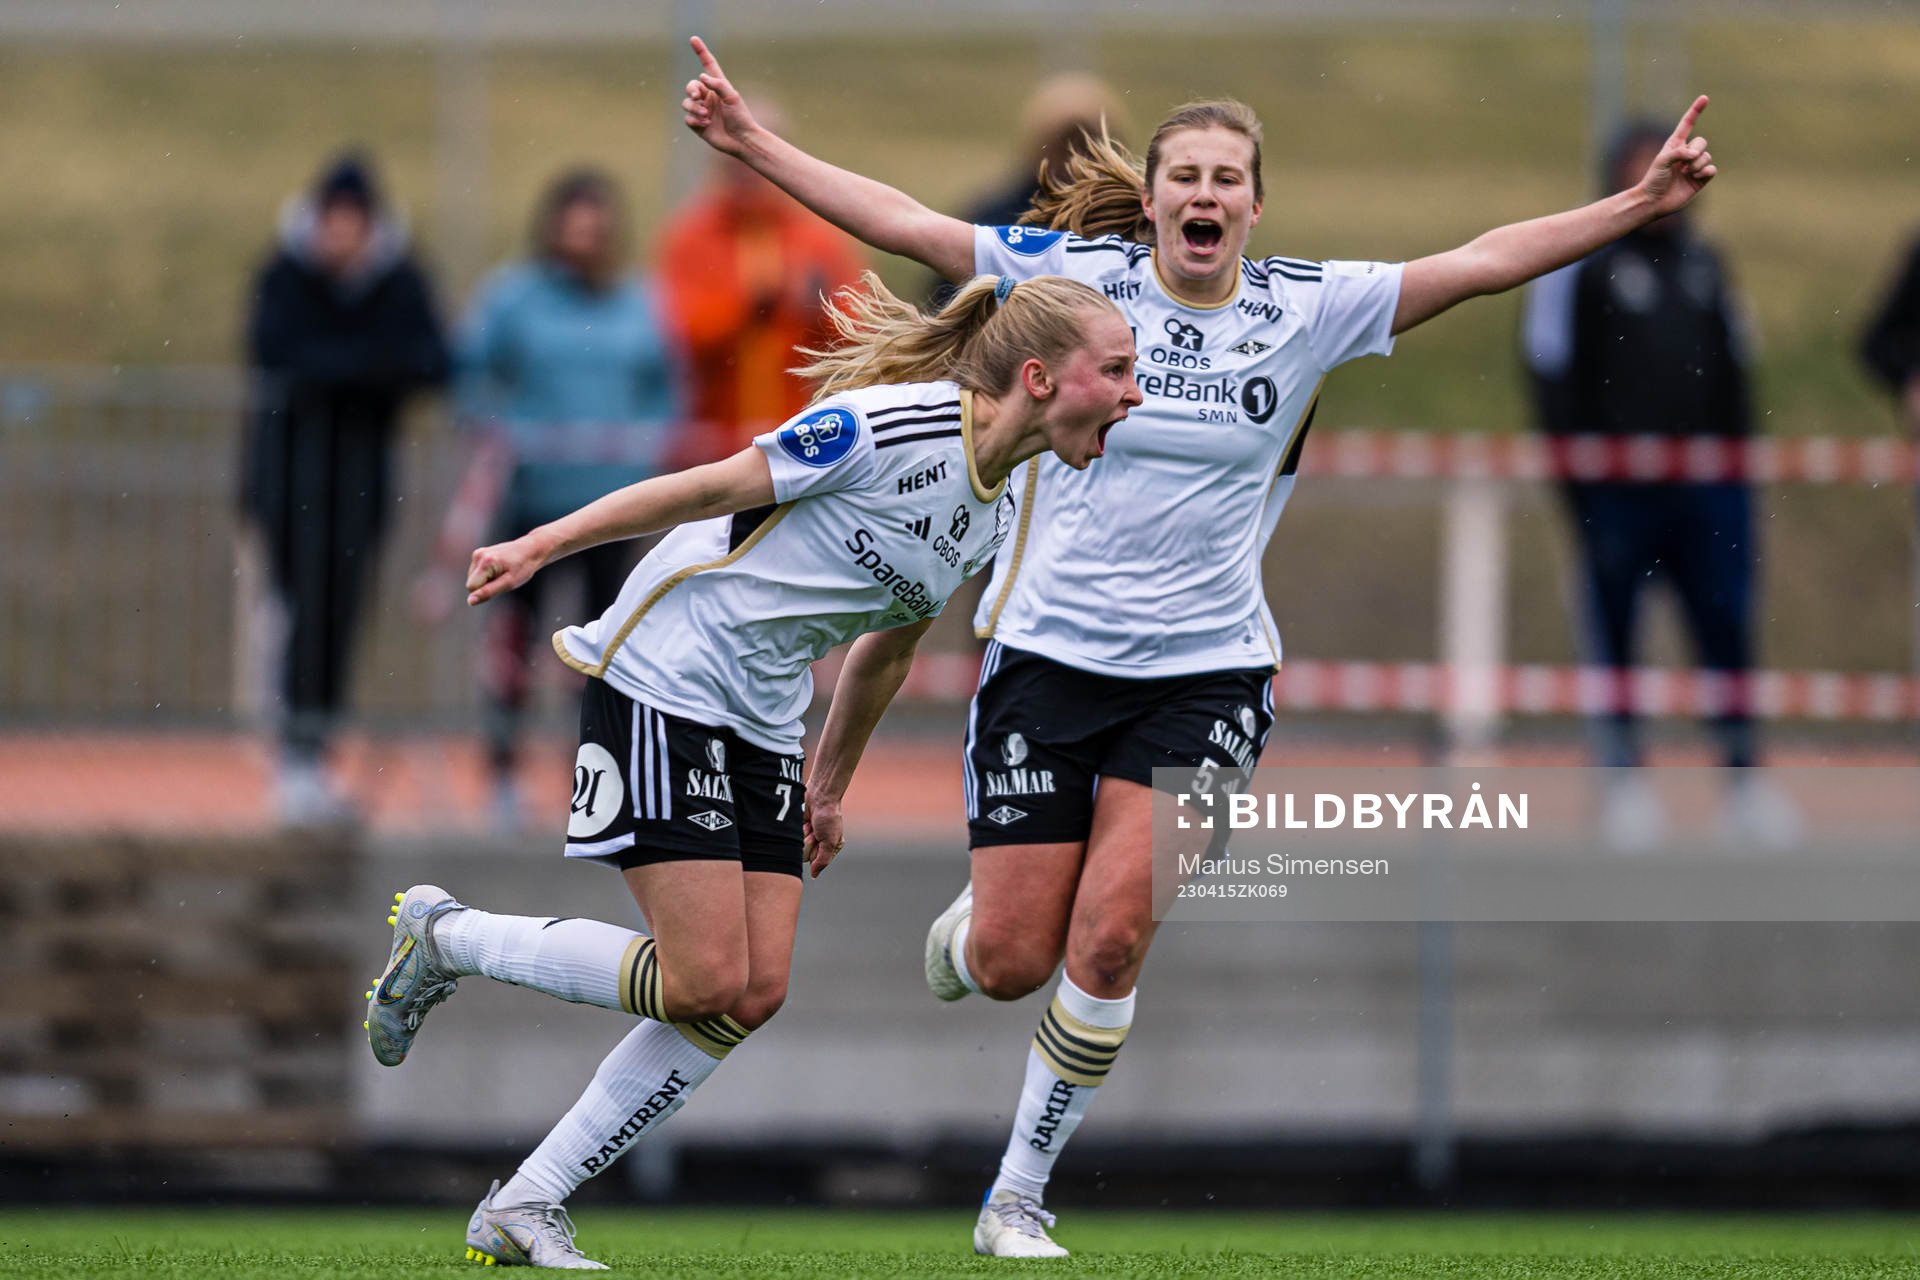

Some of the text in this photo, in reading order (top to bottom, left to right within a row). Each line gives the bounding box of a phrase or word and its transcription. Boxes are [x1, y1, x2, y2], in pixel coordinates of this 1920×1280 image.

[1150, 347, 1212, 370] OBOS
[1198, 408, 1238, 423] SMN
[898, 460, 947, 495] HENT
[933, 535, 961, 568] OBOS
[845, 528, 939, 619] SpareBank
[1191, 756, 1220, 794] 5
[775, 783, 792, 821] 7
[581, 1069, 690, 1175] RAMIRENT
